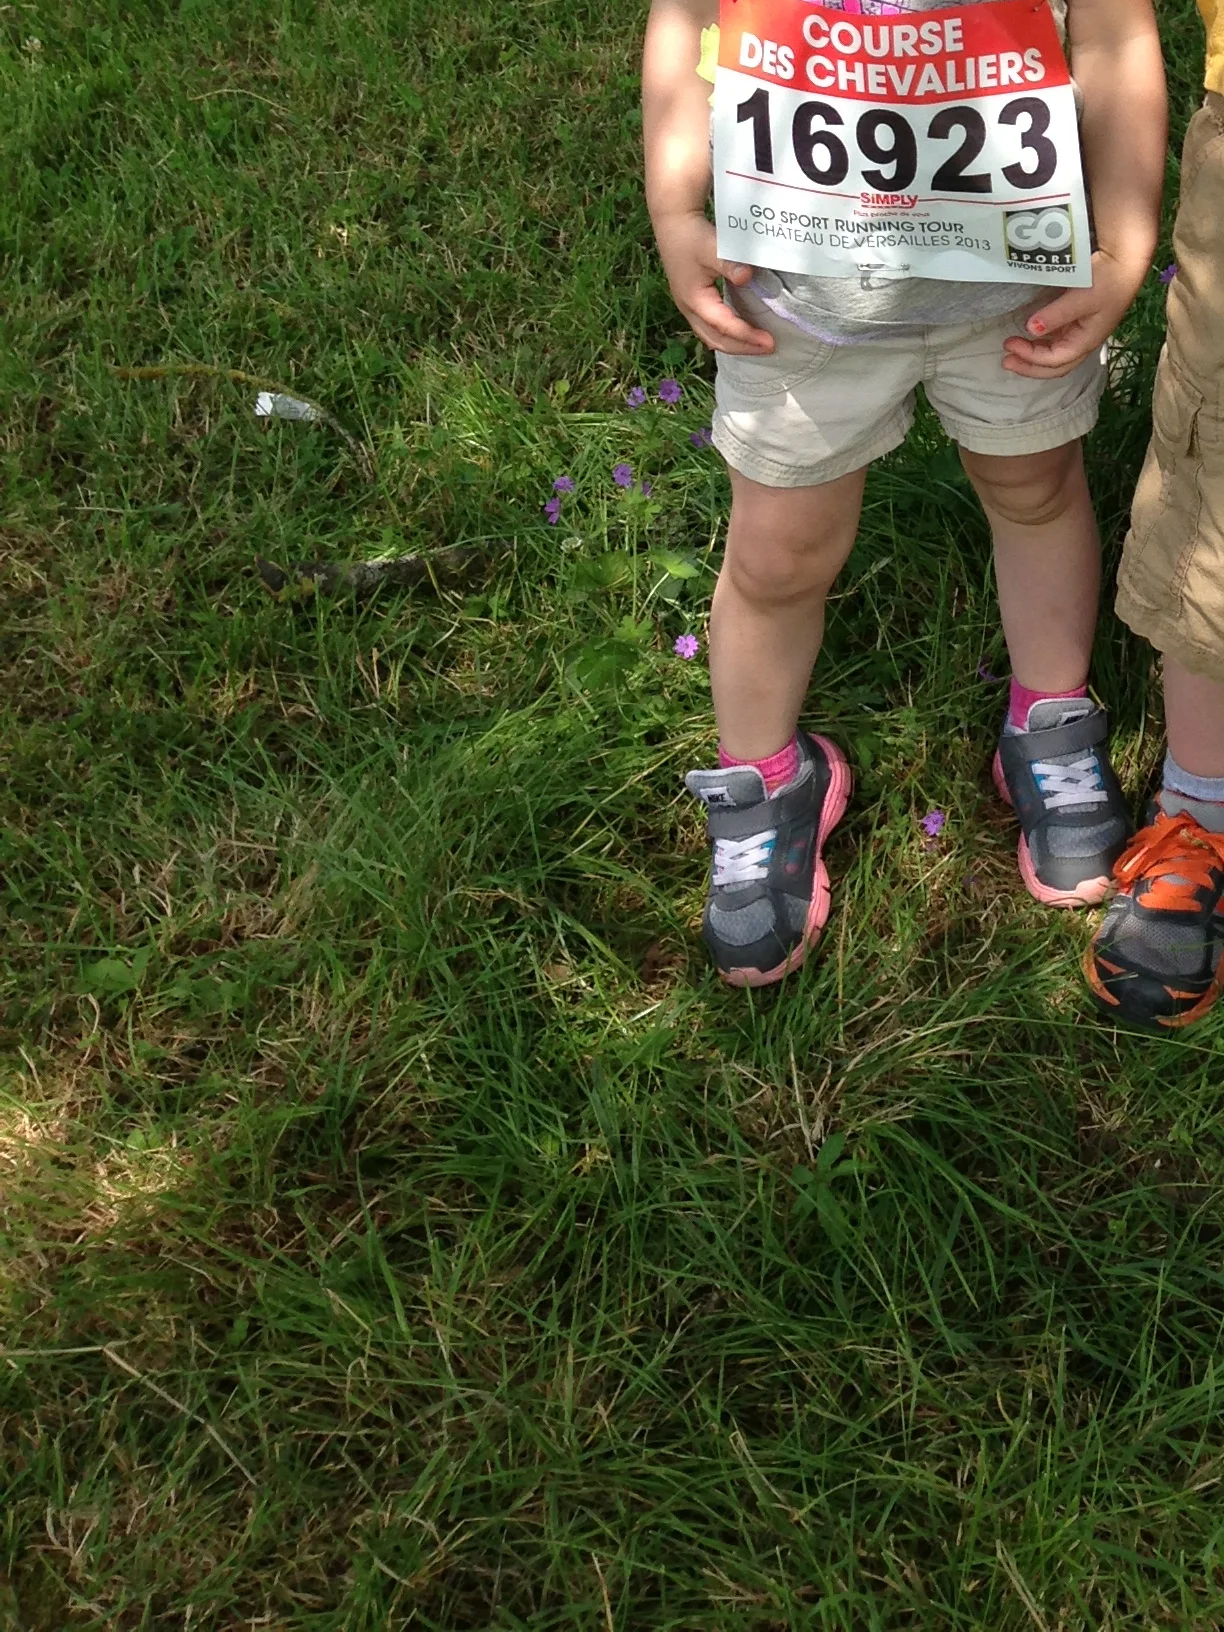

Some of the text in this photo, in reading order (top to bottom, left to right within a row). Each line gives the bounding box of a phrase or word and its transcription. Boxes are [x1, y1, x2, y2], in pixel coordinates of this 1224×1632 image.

[802, 13, 965, 58] COURSE
[738, 32, 1046, 97] DES CHEVALIERS
[736, 87, 1058, 194] 16923
[727, 215, 991, 251] DU CHÂTEAU DE VERSAILLES 2013
[749, 204, 964, 234] GO SPORT RUNNING TOUR
[1006, 207, 1072, 252] GO
[1006, 260, 1077, 273] VIVONS SPORT
[1010, 252, 1072, 264] SPORT
